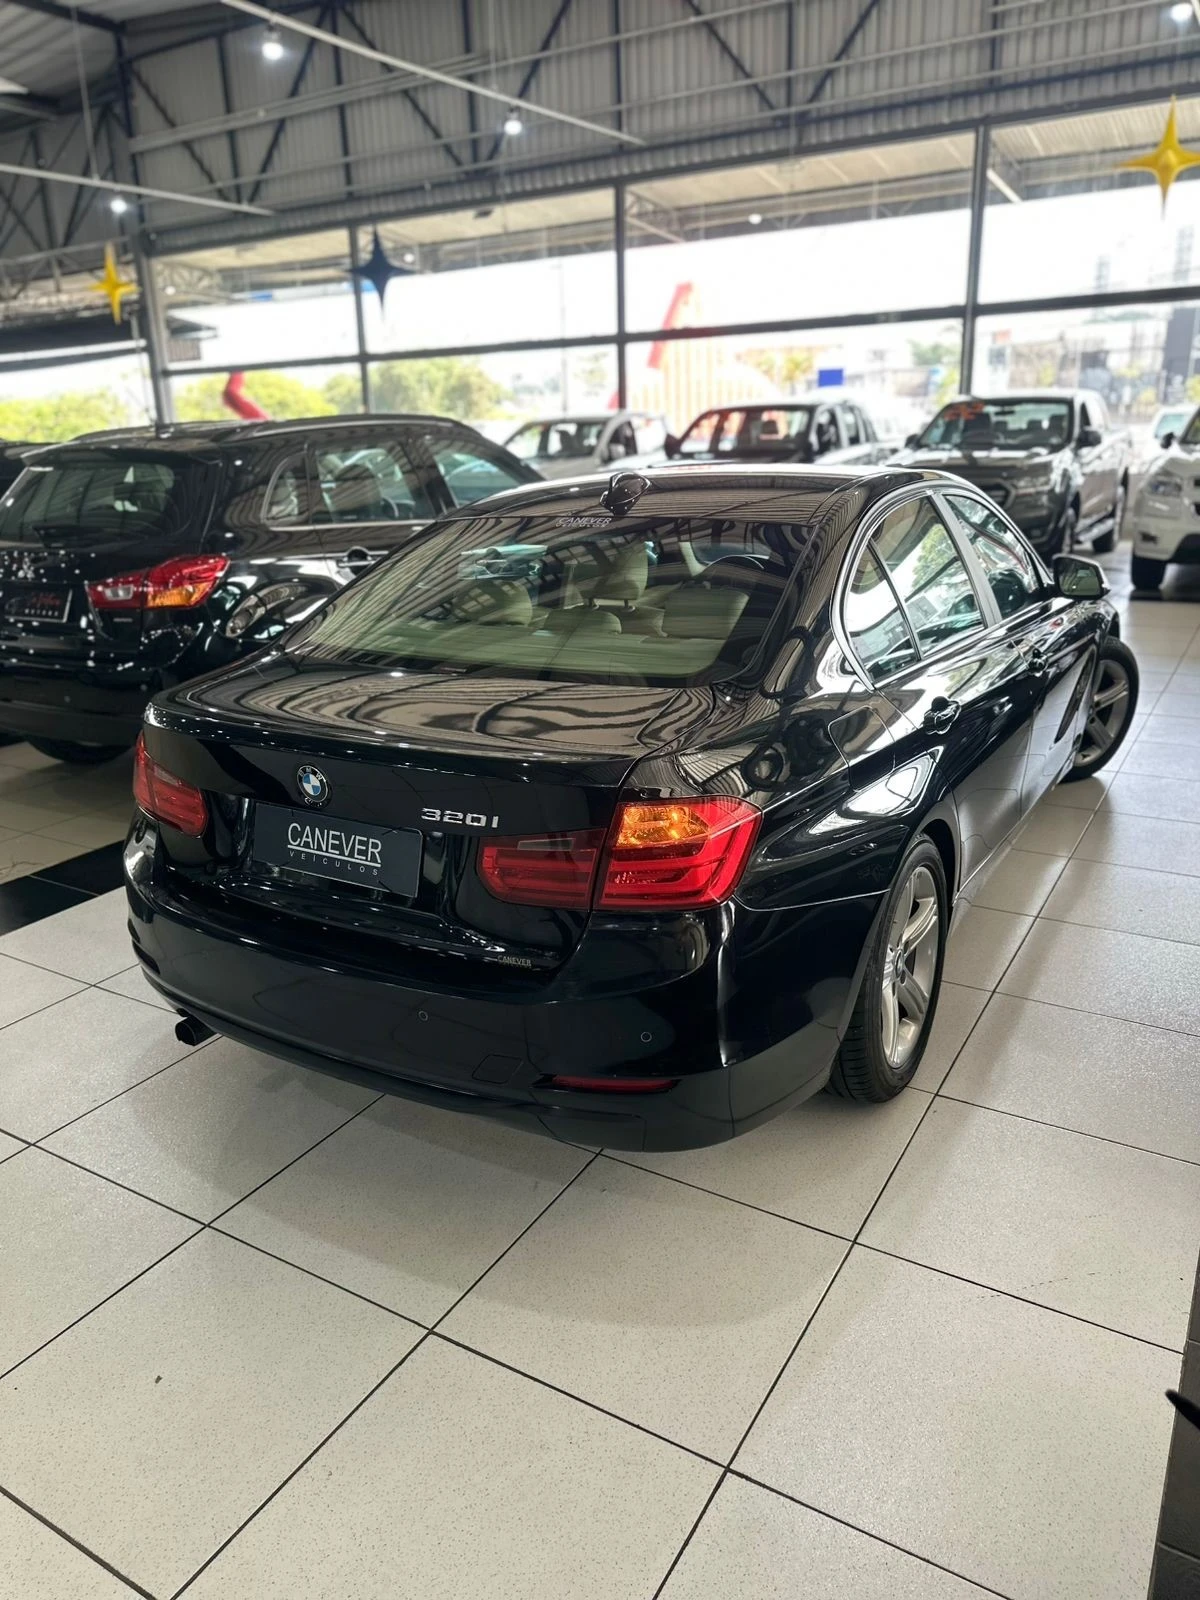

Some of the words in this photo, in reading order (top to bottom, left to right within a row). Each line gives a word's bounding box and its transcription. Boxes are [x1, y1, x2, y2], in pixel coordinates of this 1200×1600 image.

[288, 823, 382, 863] CANEVER
[289, 850, 378, 876] VEICULOS
[497, 955, 532, 967] CANEVER
